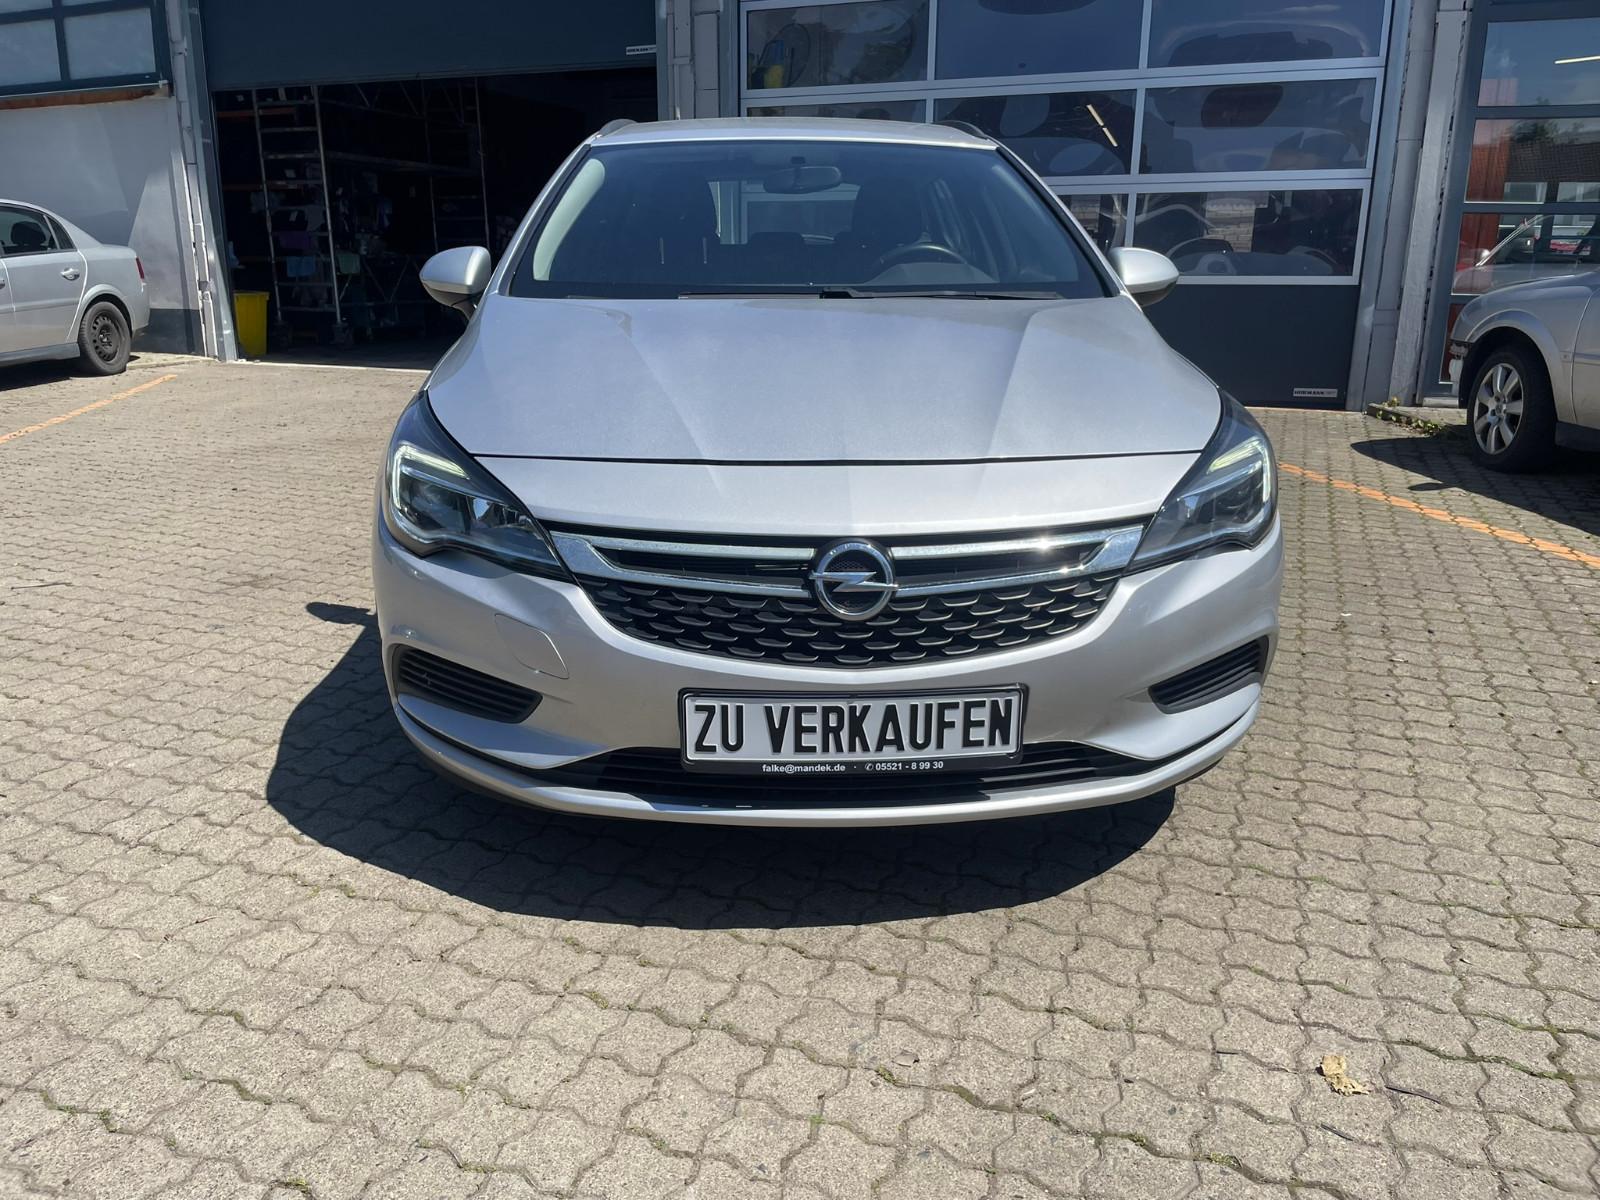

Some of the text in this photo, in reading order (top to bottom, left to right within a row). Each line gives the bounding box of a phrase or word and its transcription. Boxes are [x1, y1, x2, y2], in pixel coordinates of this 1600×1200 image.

[694, 698, 1014, 754] ZU VERKAUFEN
[762, 763, 846, 774] falke@mandek.de
[875, 762, 902, 771] 05521
[911, 761, 917, 770] 8
[919, 761, 931, 770] 99
[932, 760, 944, 769] 30
